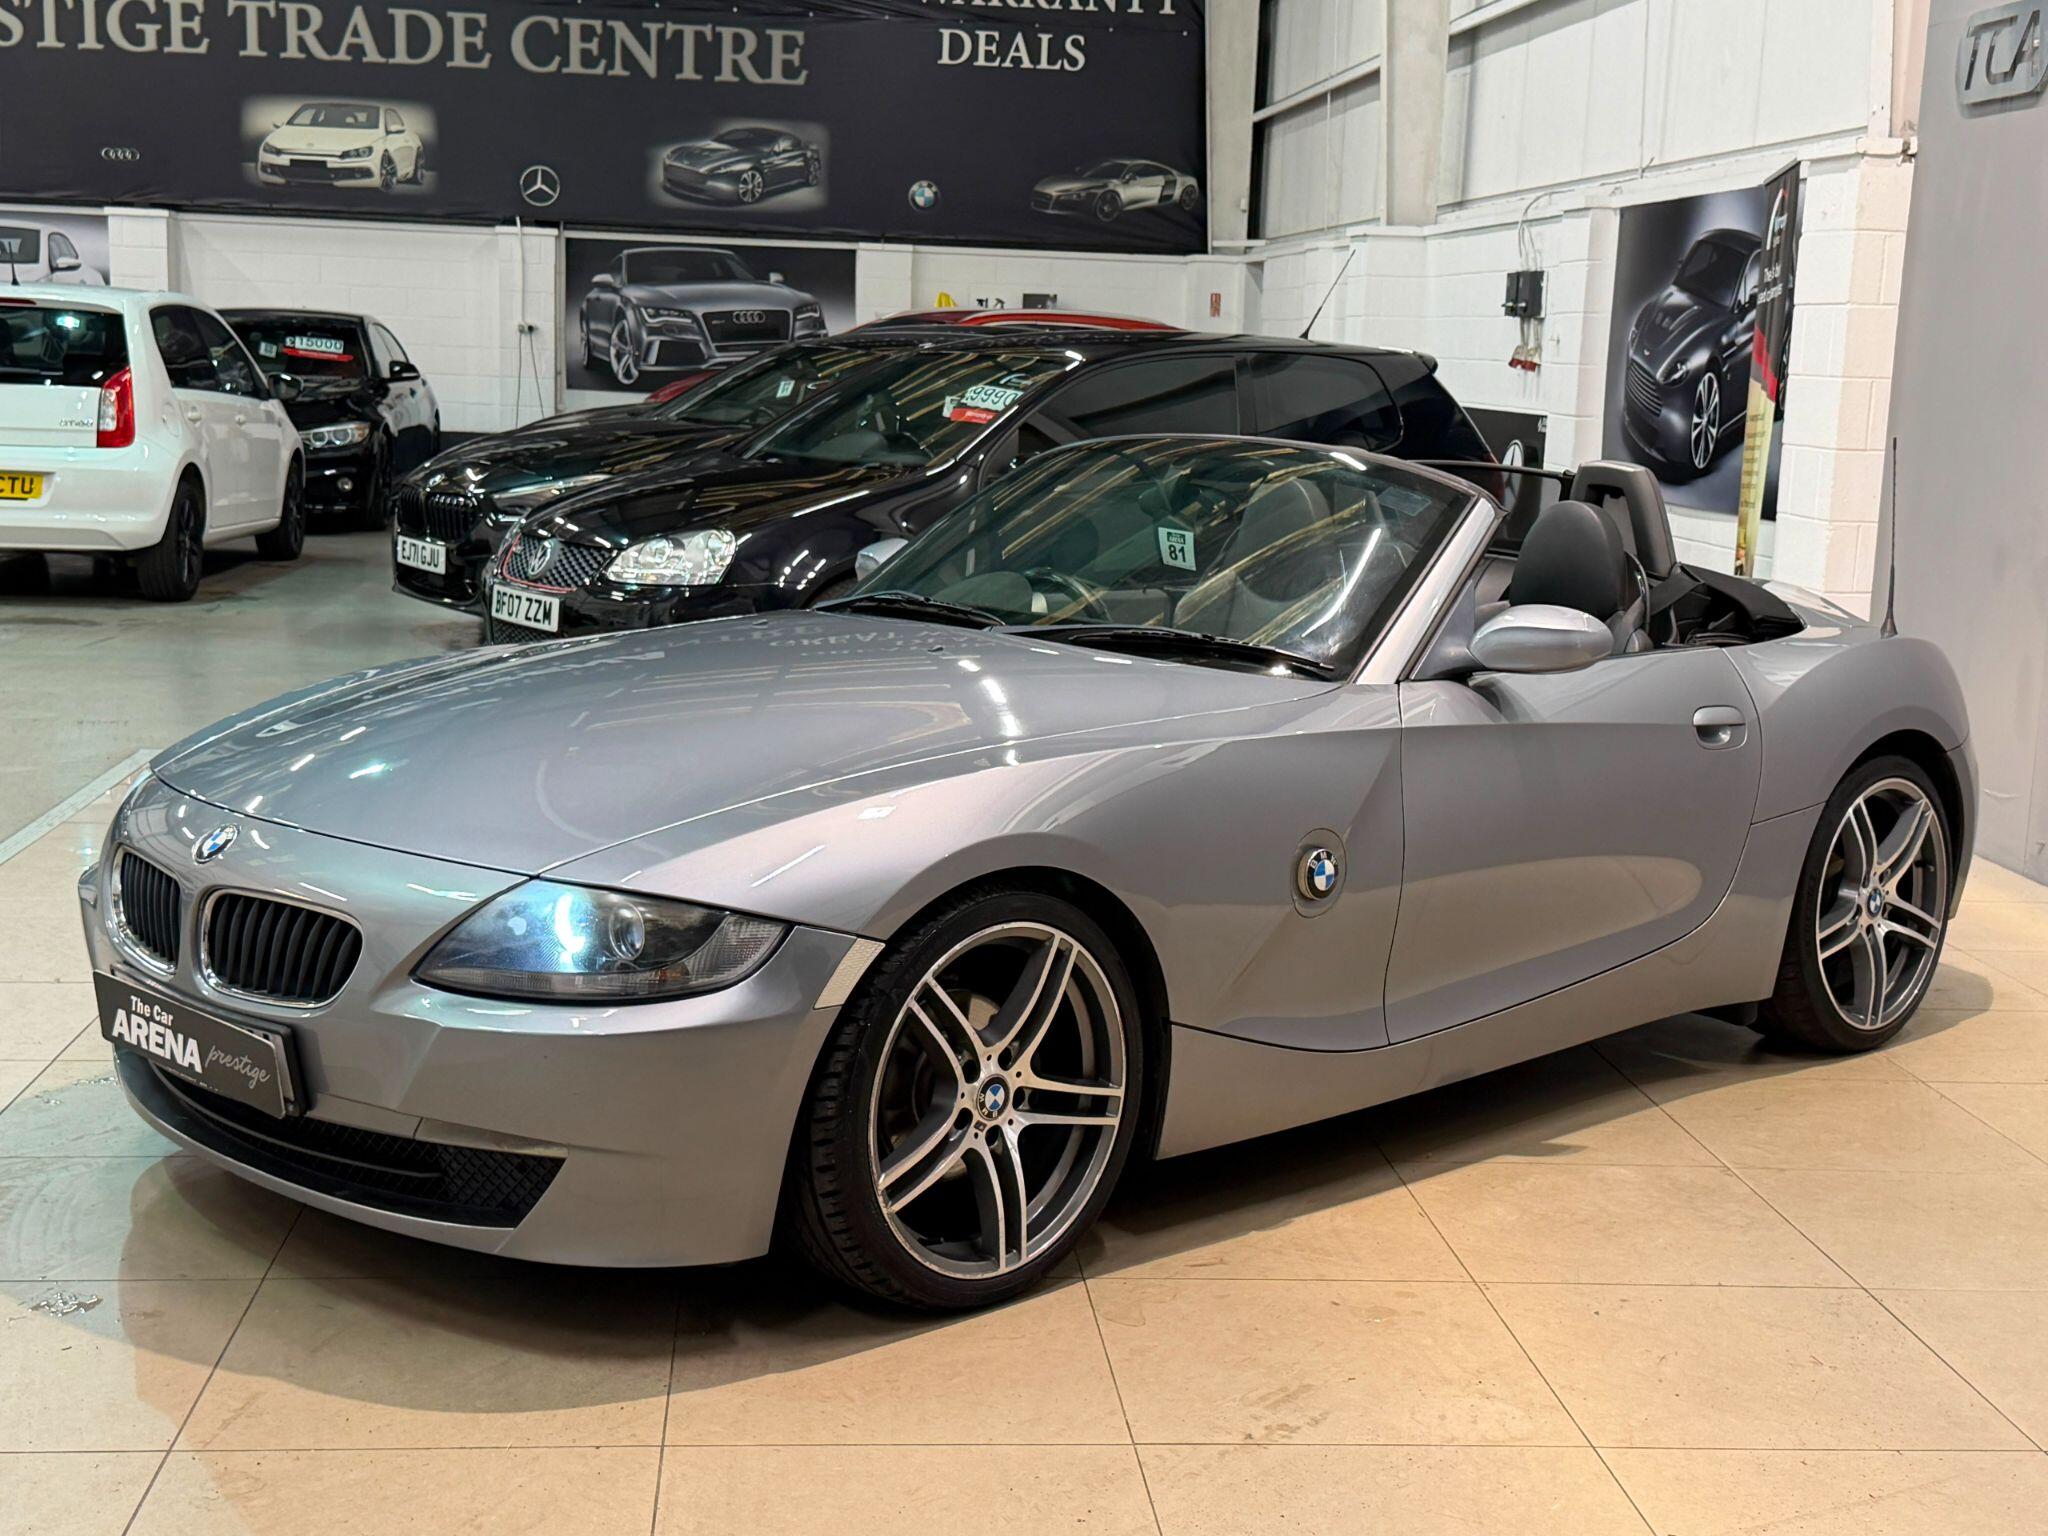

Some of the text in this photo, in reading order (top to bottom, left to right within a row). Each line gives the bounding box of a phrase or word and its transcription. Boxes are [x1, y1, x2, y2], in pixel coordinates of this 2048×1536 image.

[226, 0, 492, 69] TRADE
[510, 15, 808, 85] CENTRE
[937, 28, 1086, 71] DEALS
[421, 545, 440, 568] GJU
[1168, 544, 1186, 563] 81
[525, 597, 553, 626] ZZM
[131, 996, 174, 1028] The Car
[112, 1008, 203, 1074] ARENA
[204, 1045, 271, 1090] prestige
